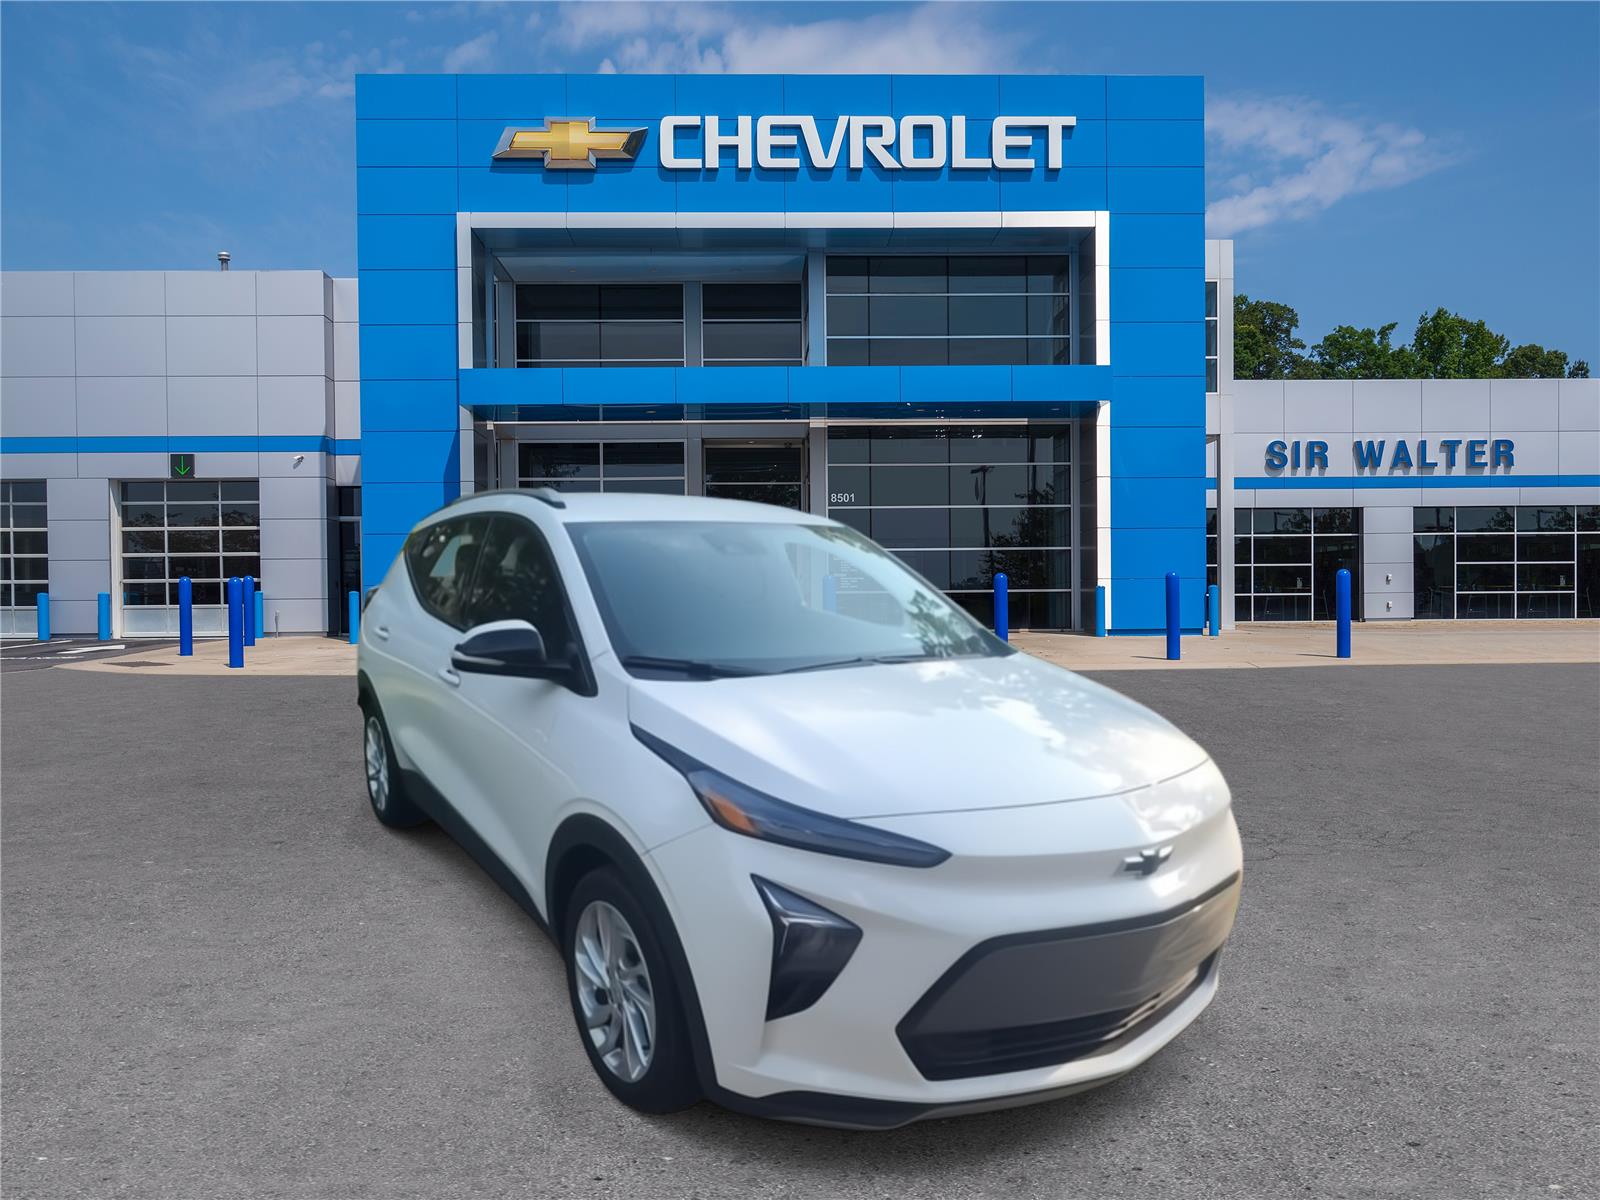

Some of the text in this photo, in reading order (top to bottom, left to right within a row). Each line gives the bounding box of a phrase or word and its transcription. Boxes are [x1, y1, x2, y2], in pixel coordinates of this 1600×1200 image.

[659, 115, 1077, 170] CHEVROLET
[1265, 439, 1516, 470] SIR WALTER
[830, 493, 856, 503] 8501
